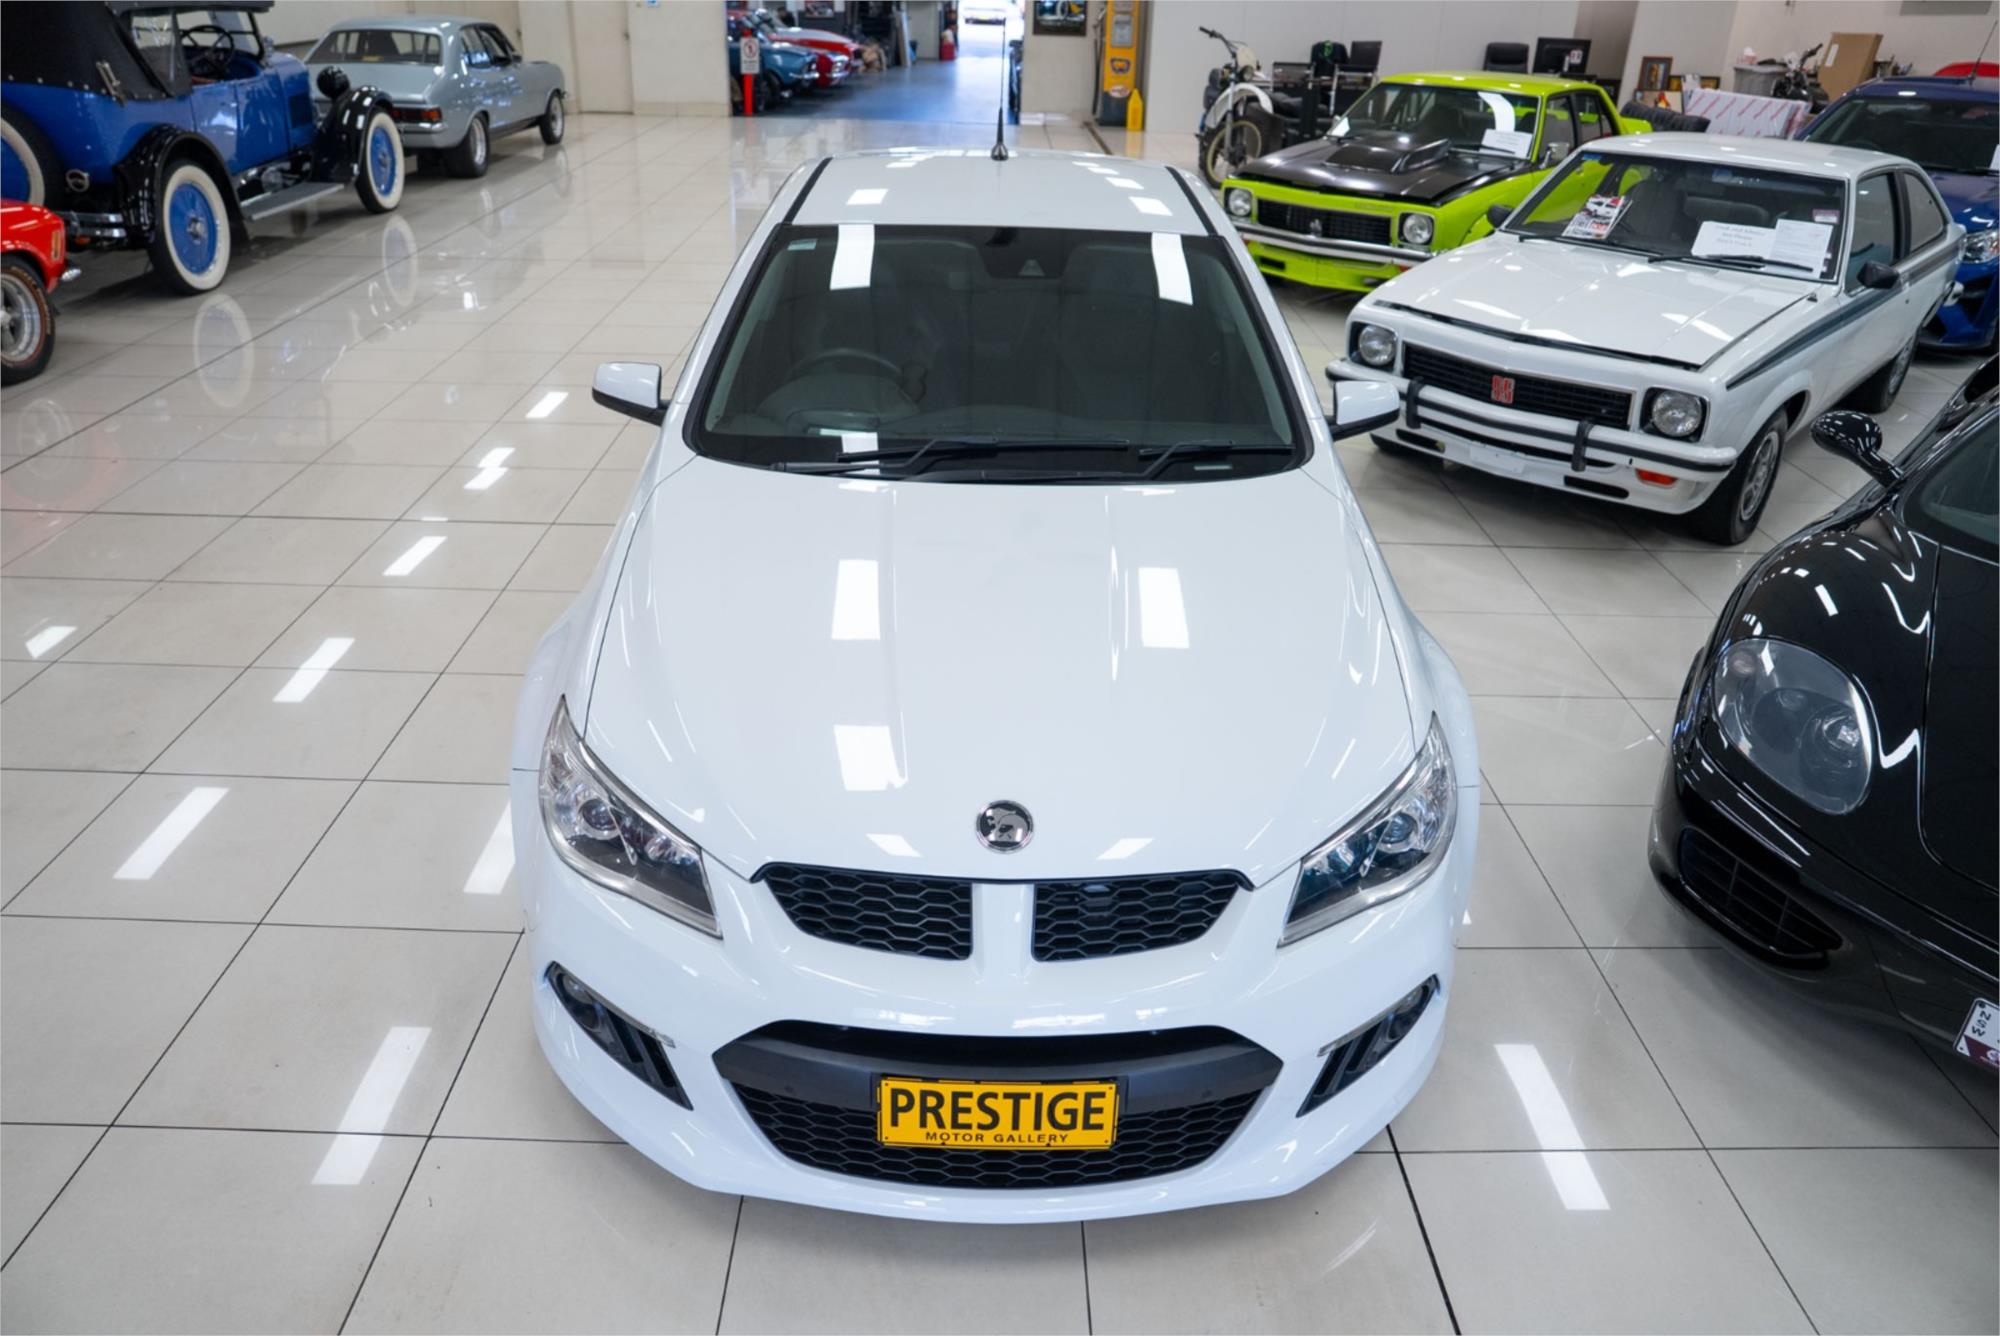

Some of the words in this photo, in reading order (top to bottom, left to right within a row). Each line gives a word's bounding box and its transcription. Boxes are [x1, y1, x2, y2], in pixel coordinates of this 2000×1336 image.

[889, 1087, 1107, 1132] PRESTIGE
[925, 1131, 985, 1144] MOTOR
[993, 1133, 1069, 1144] GALLERY
